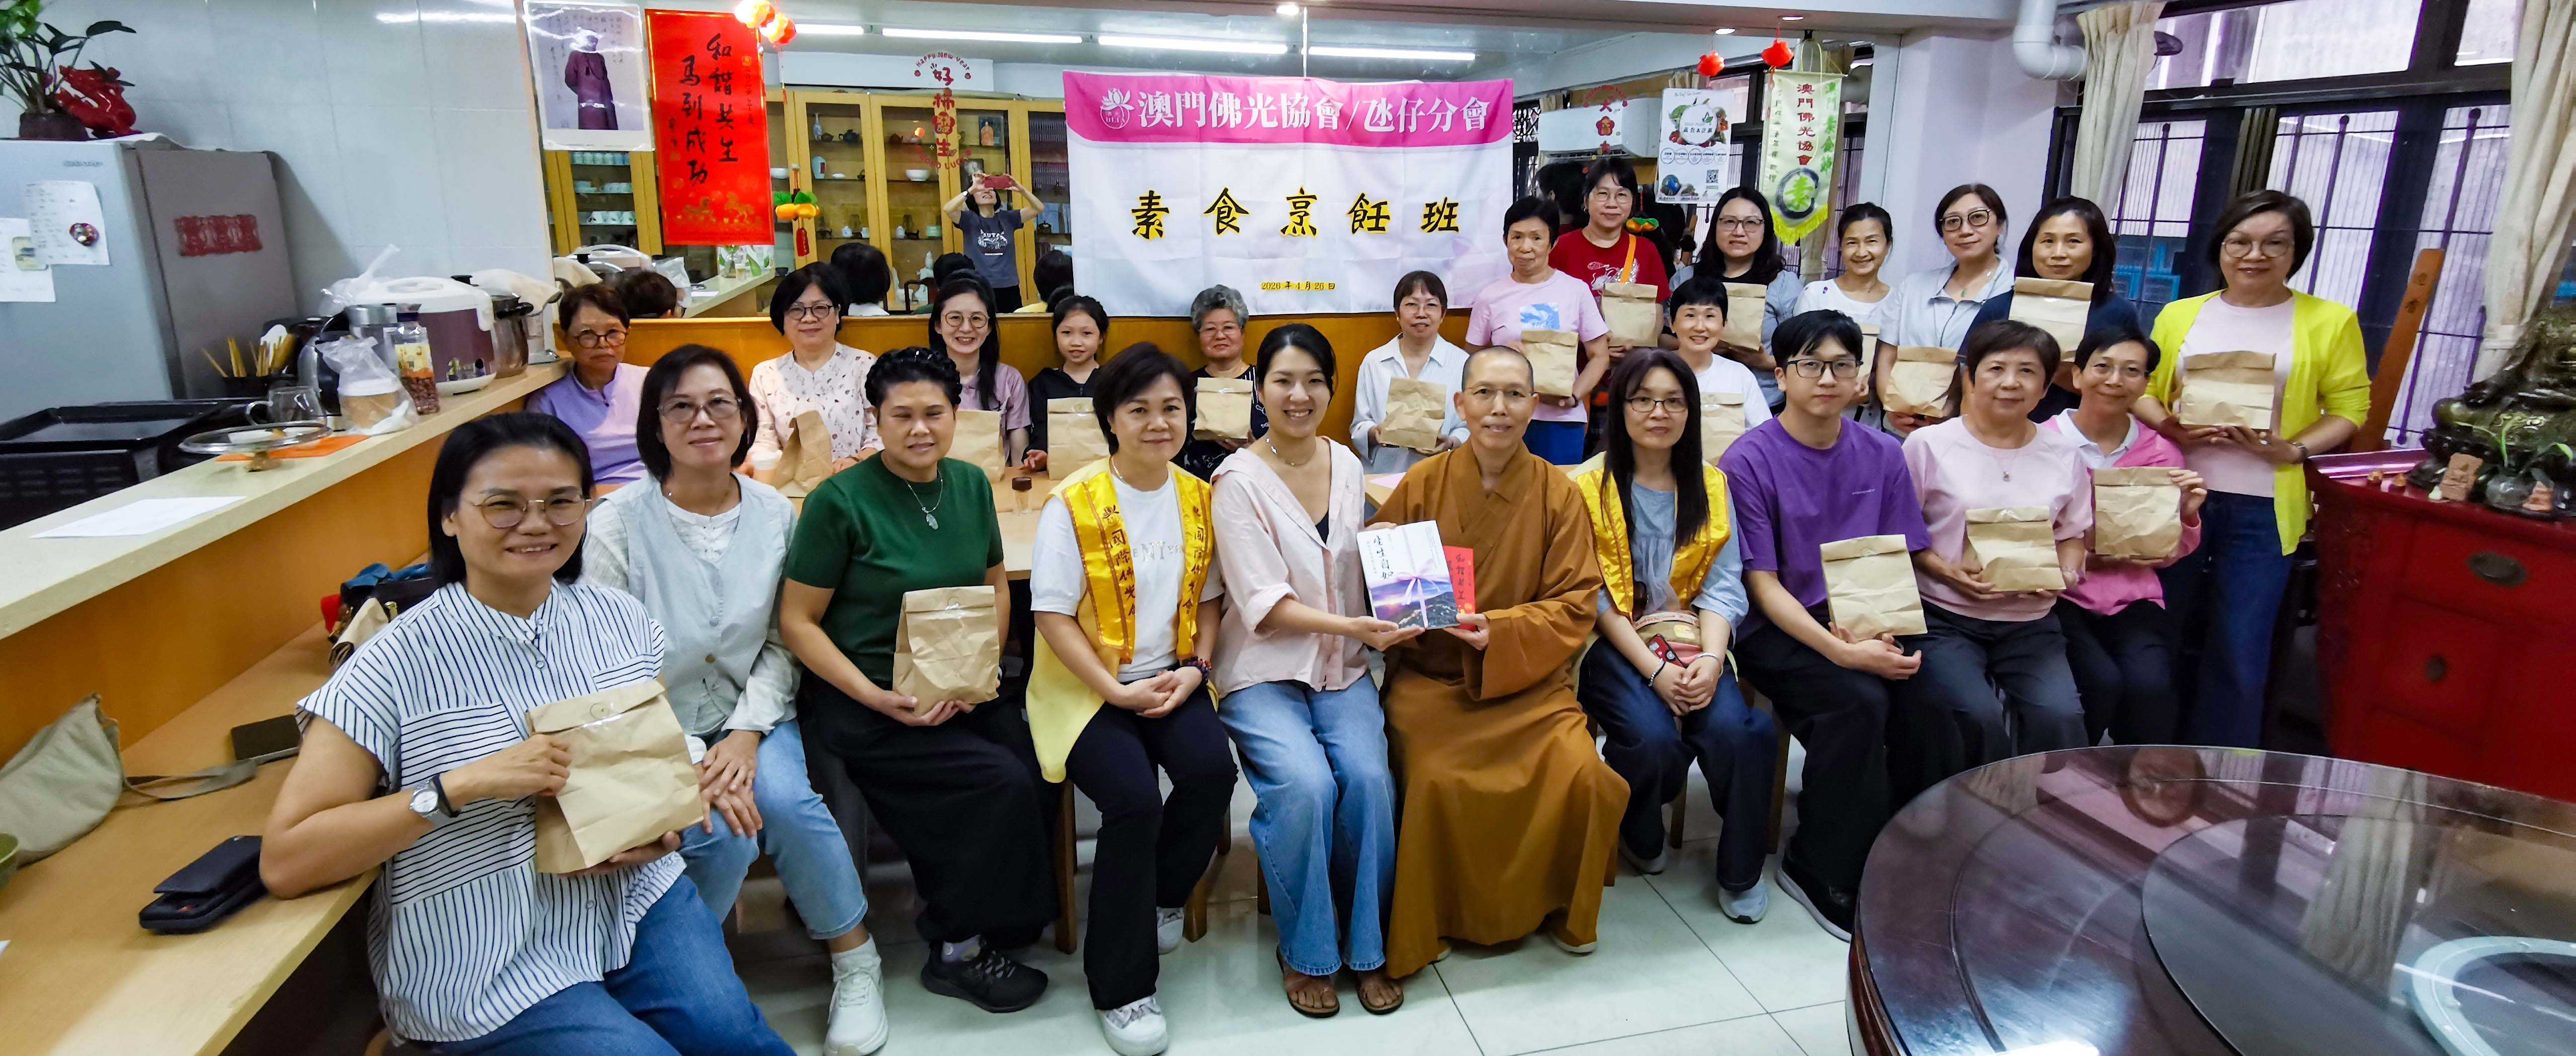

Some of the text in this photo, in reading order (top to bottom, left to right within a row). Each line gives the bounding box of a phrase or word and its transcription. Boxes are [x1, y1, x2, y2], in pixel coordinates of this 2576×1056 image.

[916, 52, 970, 70] Happy New Year
[1138, 91, 1490, 133] 澳門佛光協會/氹仔分會
[1797, 84, 1816, 166] 澳門佛光協會
